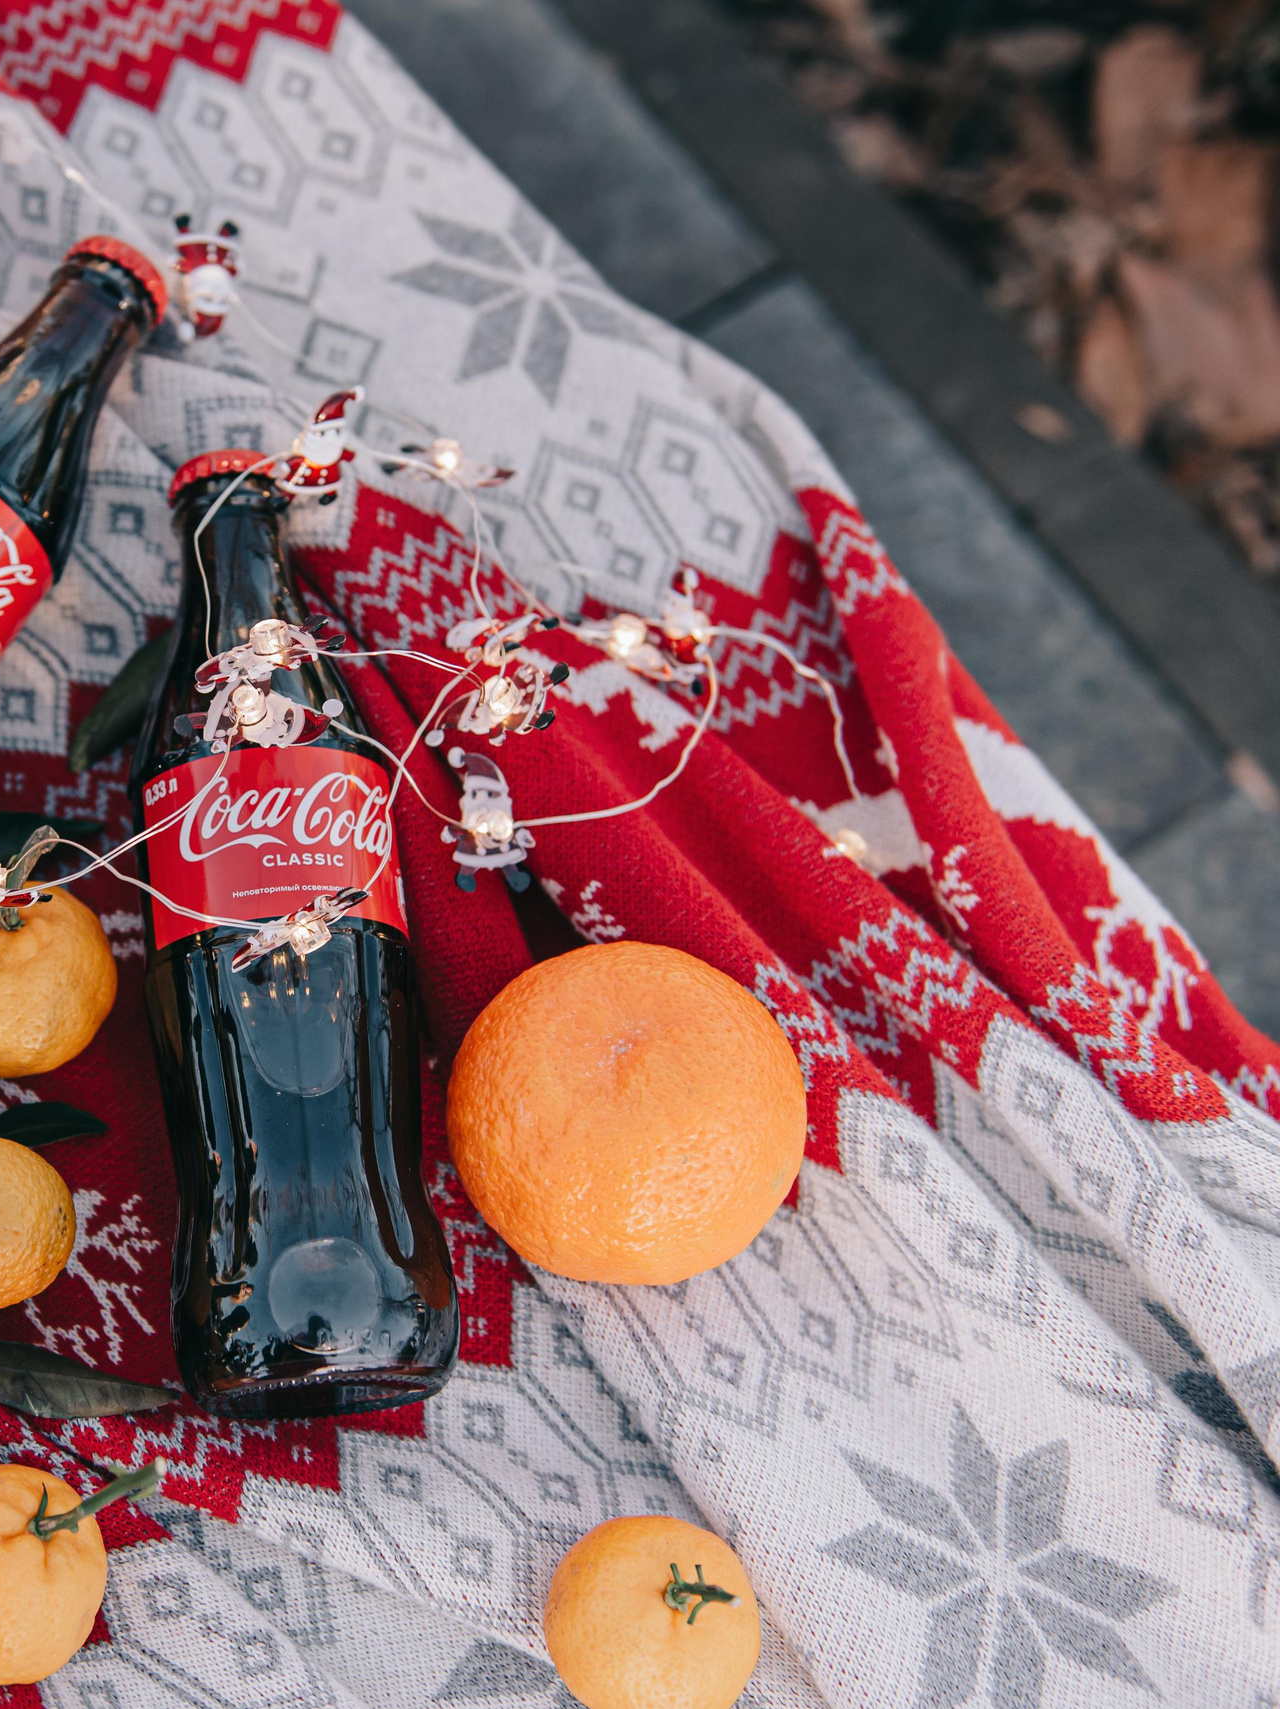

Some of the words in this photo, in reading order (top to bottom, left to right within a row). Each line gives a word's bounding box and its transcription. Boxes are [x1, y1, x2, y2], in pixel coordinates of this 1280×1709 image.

[145, 779, 167, 806] 0,33
[179, 772, 390, 862] Coca-Cola
[262, 852, 344, 868] CLASSIC
[232, 883, 300, 899] Неповторимый
